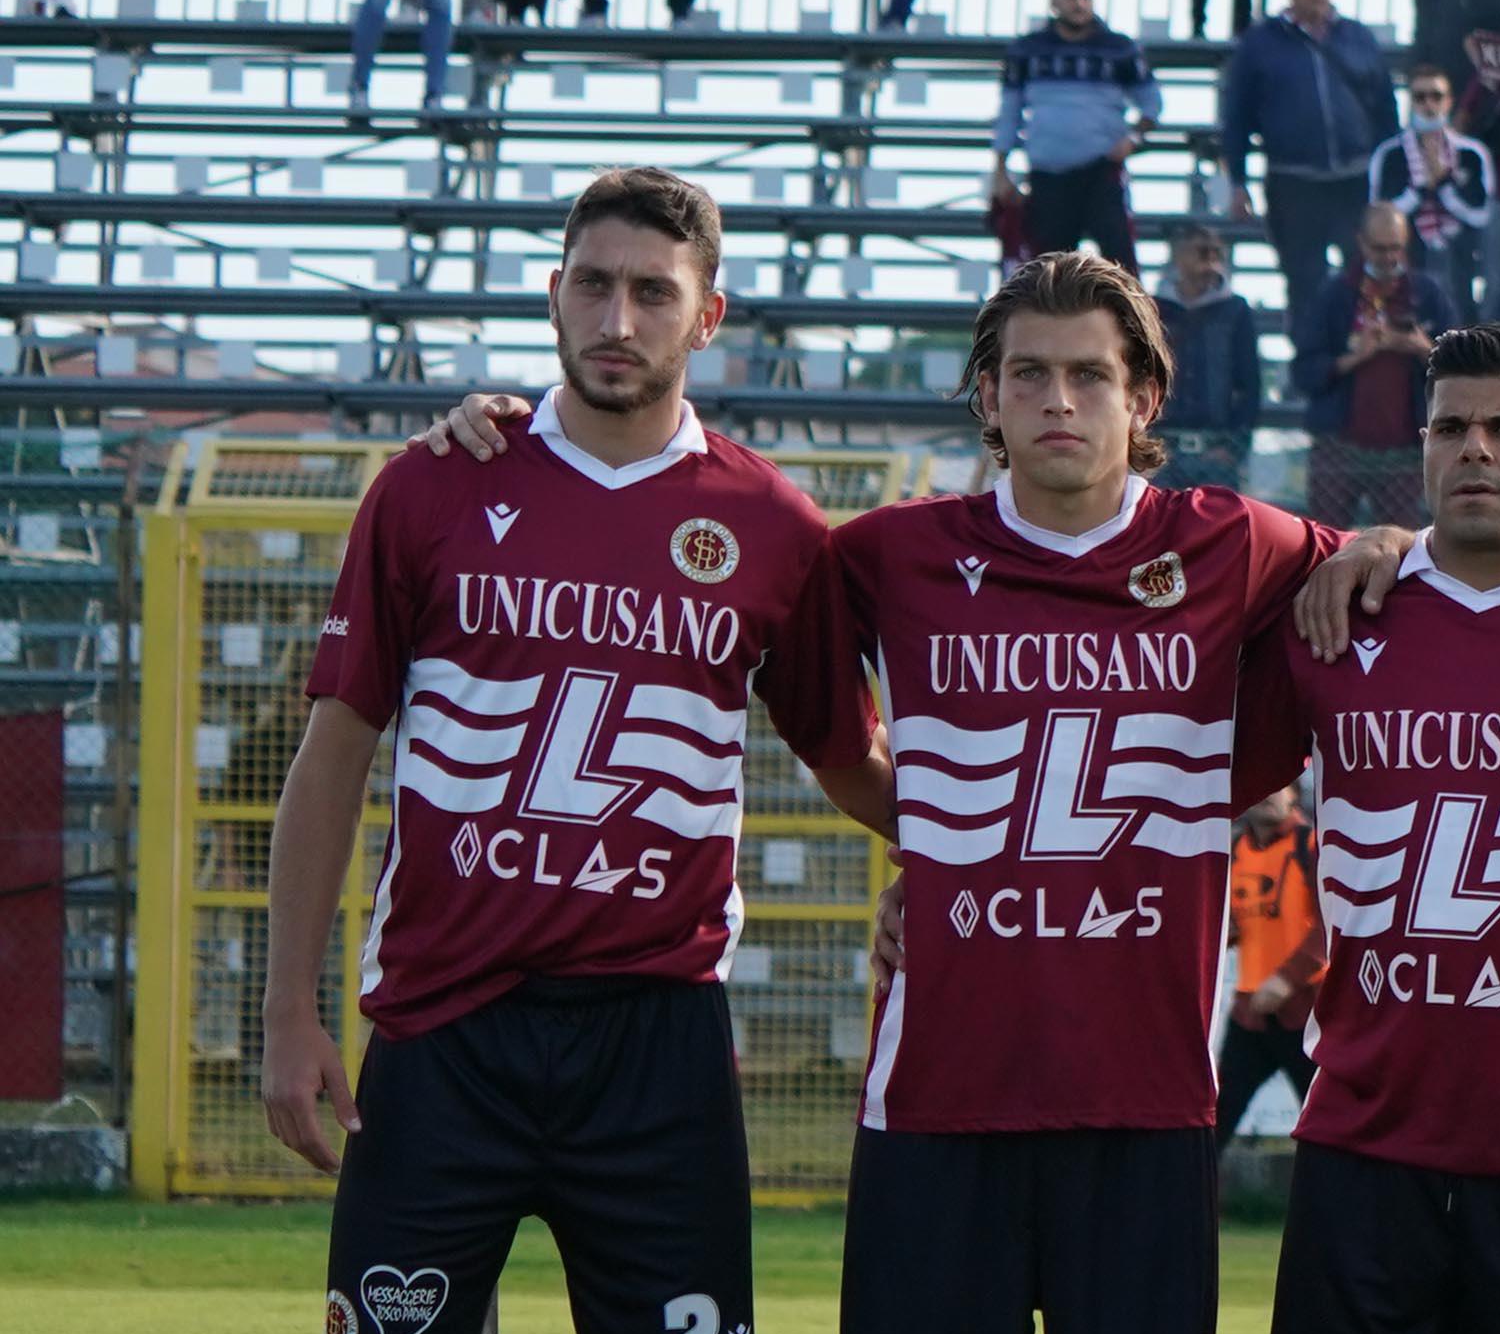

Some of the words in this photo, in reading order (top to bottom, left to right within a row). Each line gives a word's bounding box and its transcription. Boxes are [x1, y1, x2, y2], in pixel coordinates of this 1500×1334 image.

[458, 573, 740, 666] UNICUSANO
[928, 631, 1197, 692] UNICUSANO
[486, 829, 673, 900] CLAS
[987, 886, 1162, 939] CLAS
